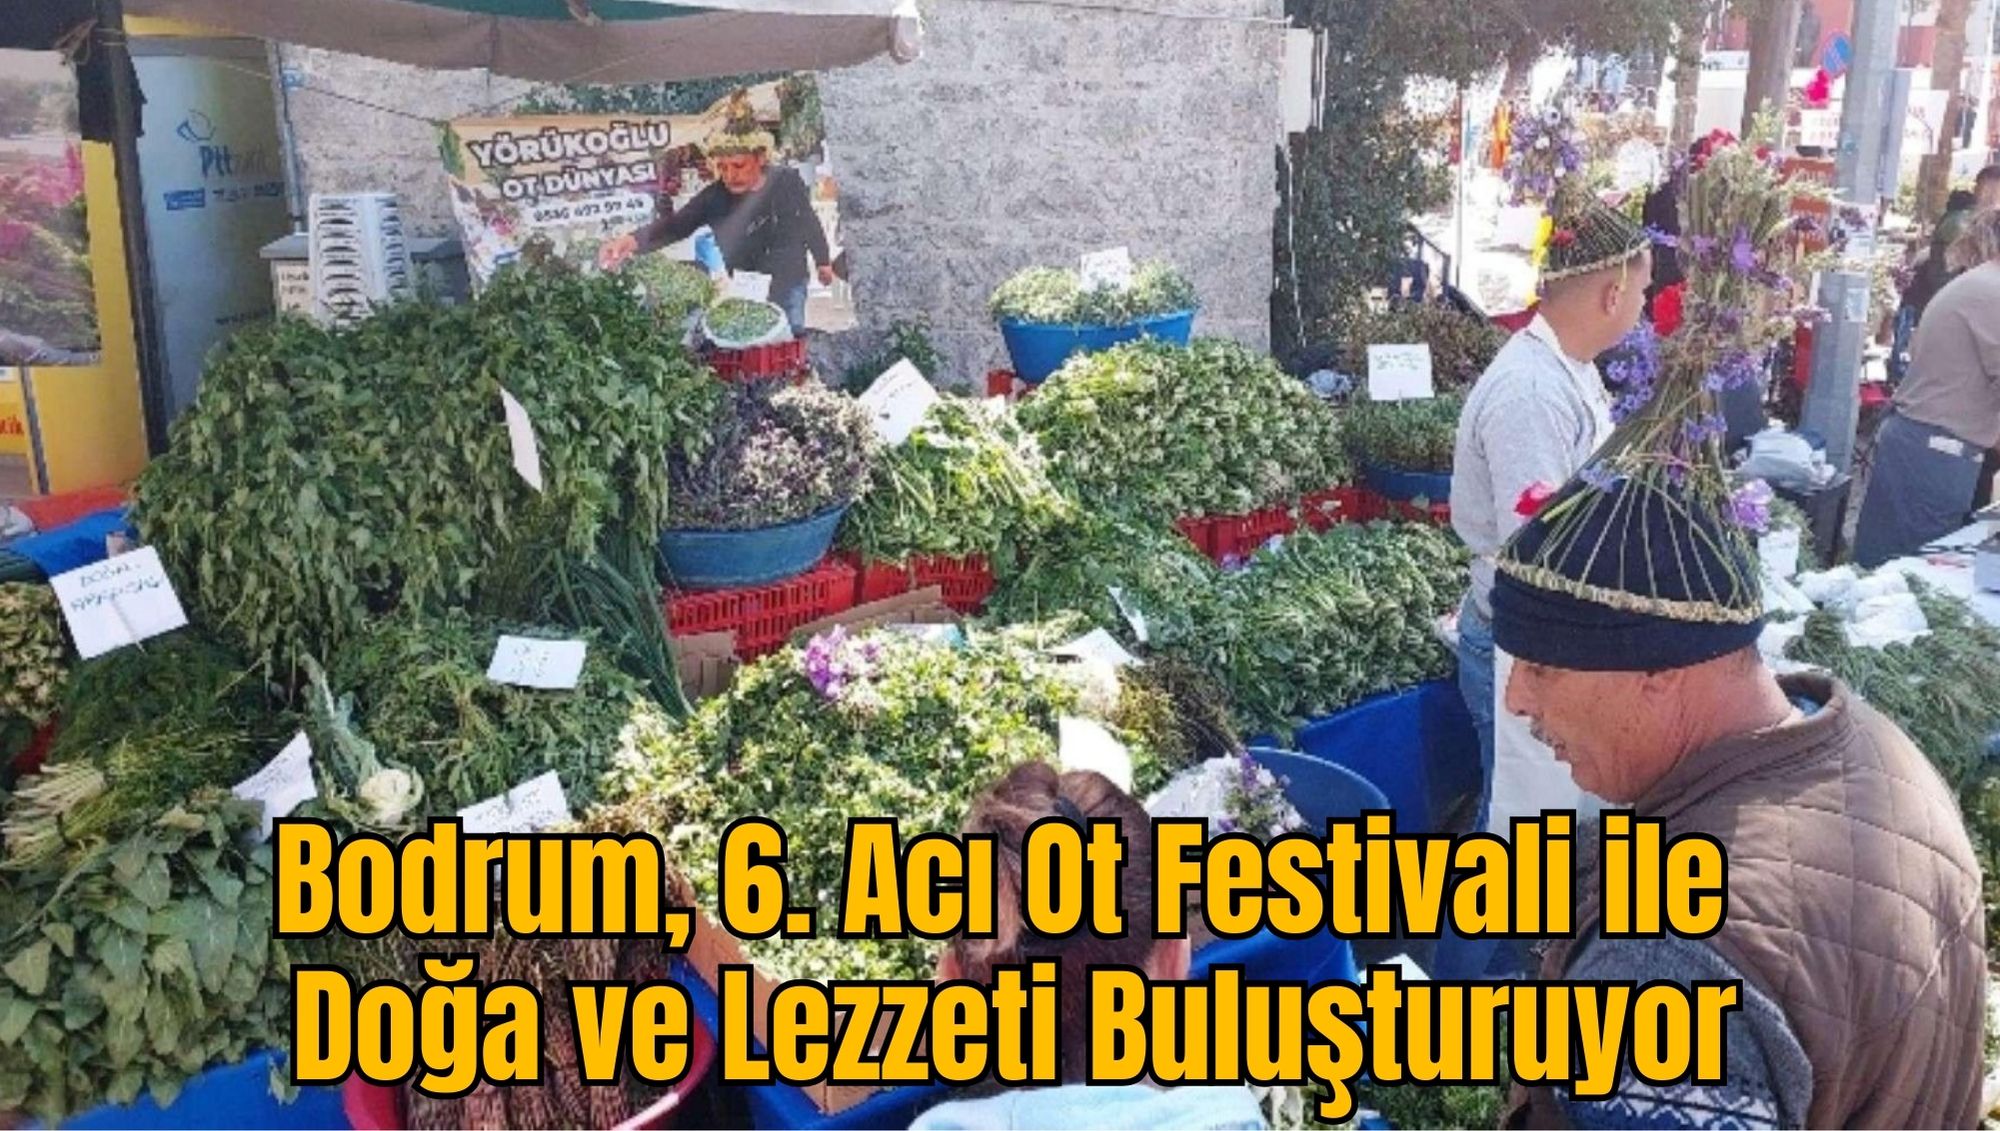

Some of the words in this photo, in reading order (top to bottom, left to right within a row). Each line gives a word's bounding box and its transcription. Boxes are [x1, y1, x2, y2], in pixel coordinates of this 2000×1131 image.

[468, 121, 670, 168] YÖRÜKOĞLU
[501, 175, 540, 199] OT
[545, 163, 657, 195] DÜNYASI
